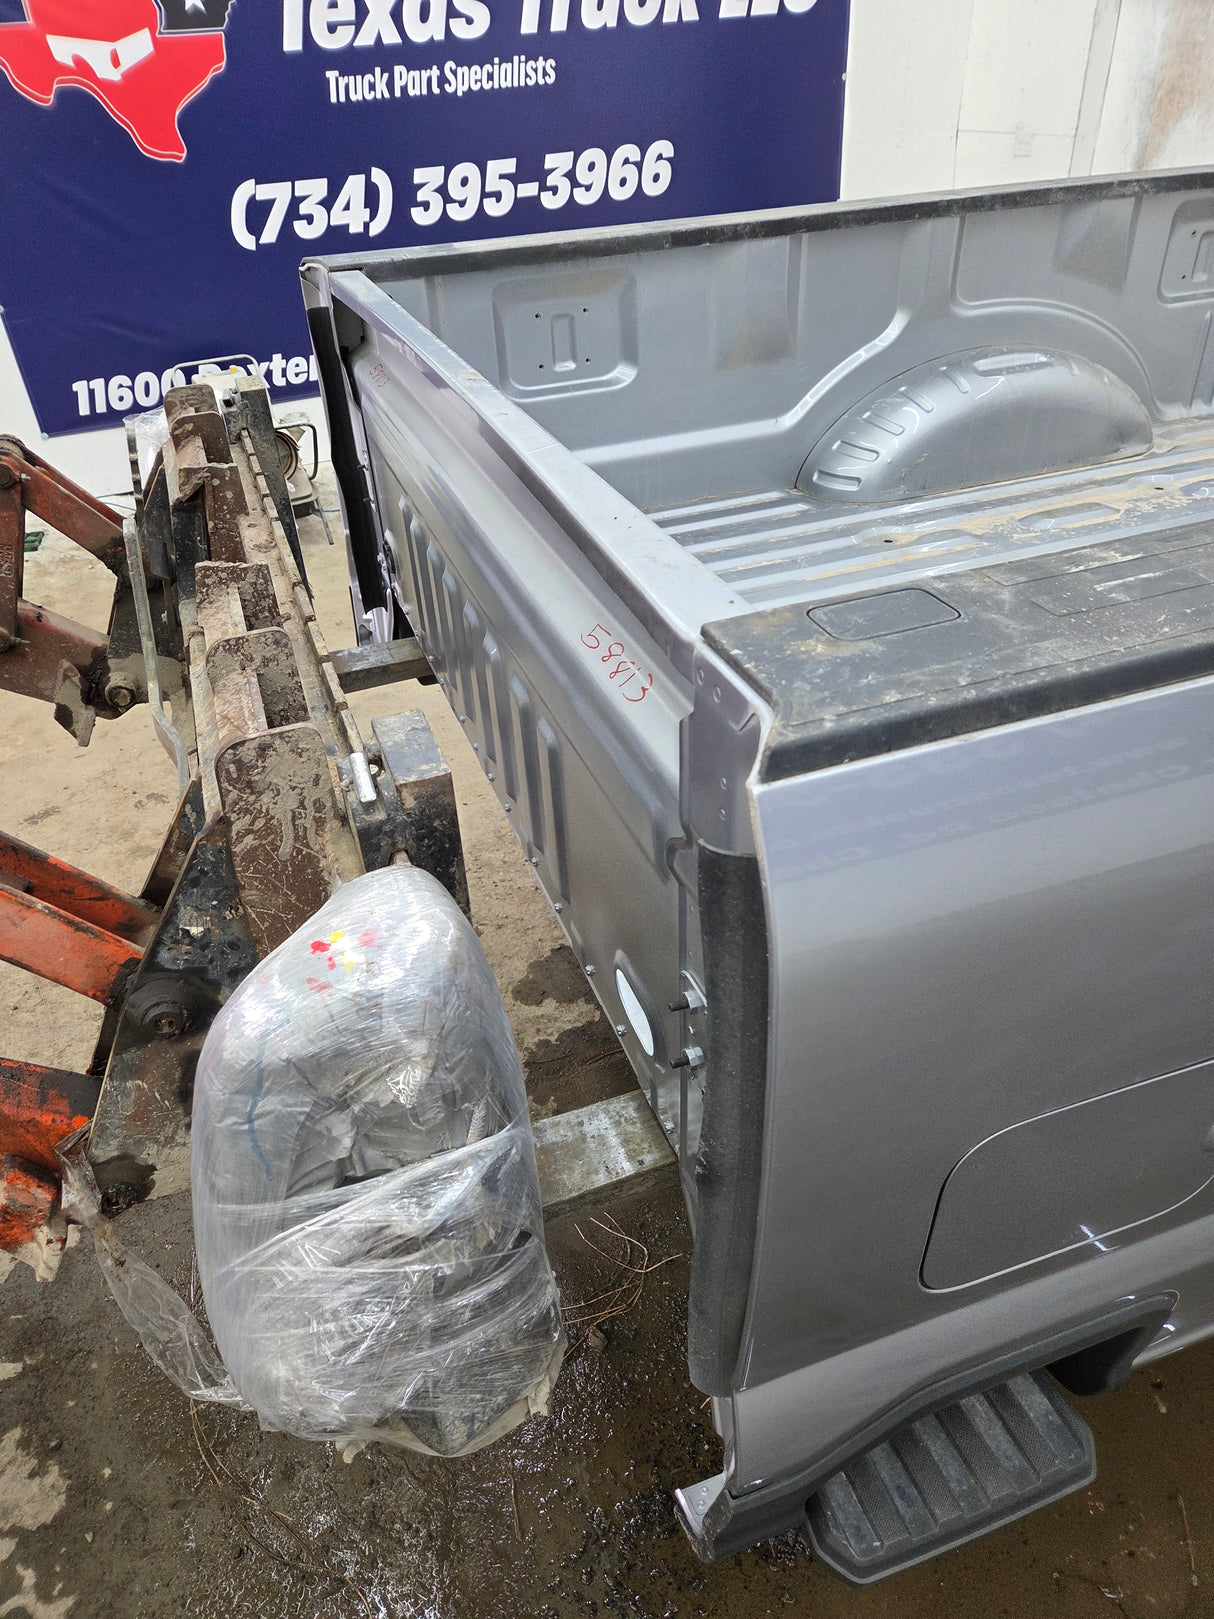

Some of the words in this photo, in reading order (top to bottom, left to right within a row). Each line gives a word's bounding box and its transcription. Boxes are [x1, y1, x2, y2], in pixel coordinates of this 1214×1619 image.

[325, 68, 390, 103] Truck
[393, 65, 440, 97] Part
[443, 55, 556, 96] Specialists
[230, 166, 393, 251] (734)
[410, 139, 675, 226] 395-3966
[72, 368, 186, 416] 11600
[197, 353, 319, 388] xter
[580, 623, 654, 703] 58813
